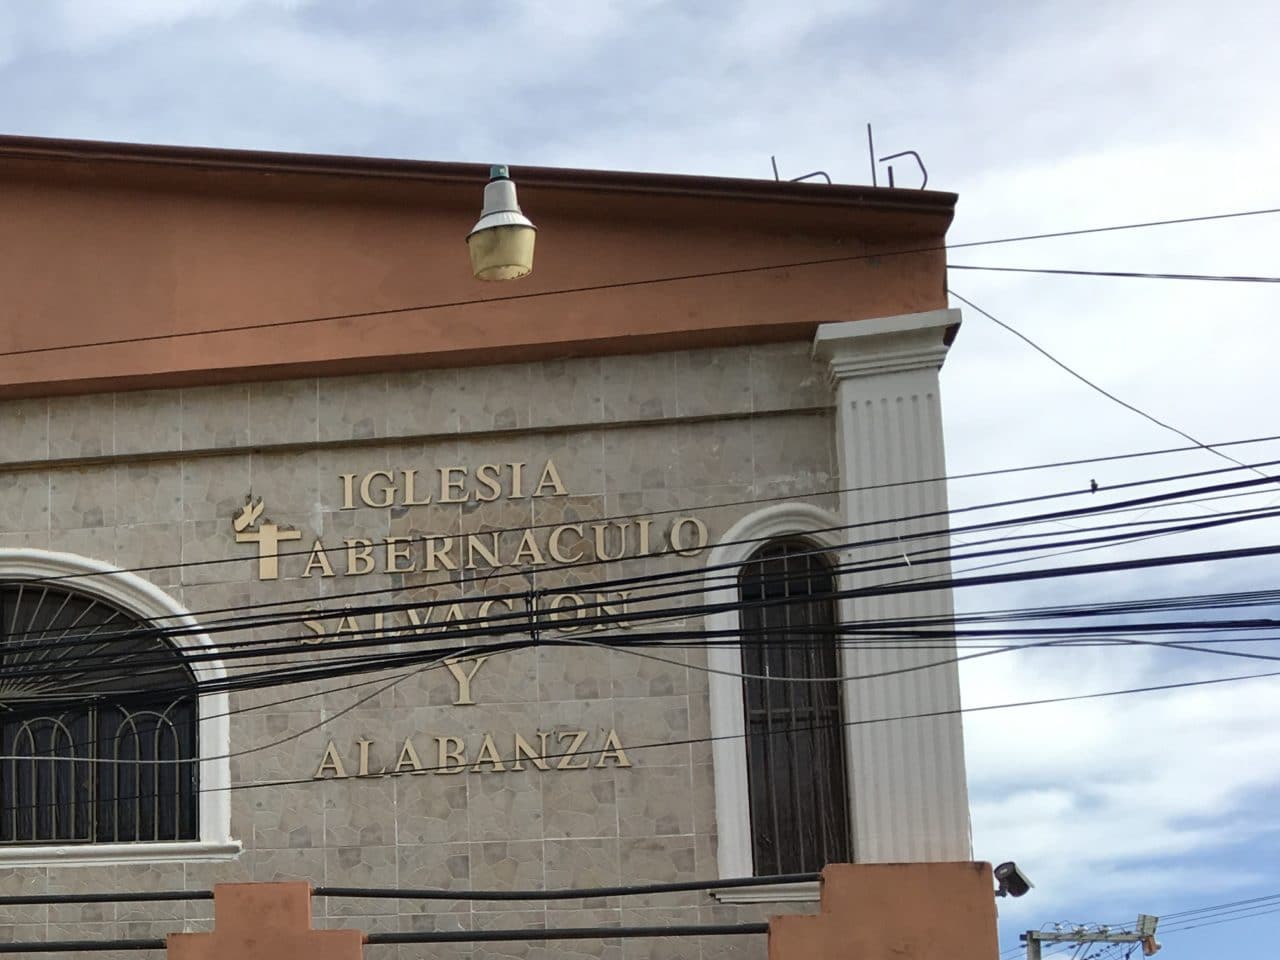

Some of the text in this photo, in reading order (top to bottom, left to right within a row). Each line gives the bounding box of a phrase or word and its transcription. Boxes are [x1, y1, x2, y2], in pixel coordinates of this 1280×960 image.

[338, 459, 569, 510] IGLESIA
[443, 656, 487, 706] Y
[313, 728, 632, 780] ALABANZA
